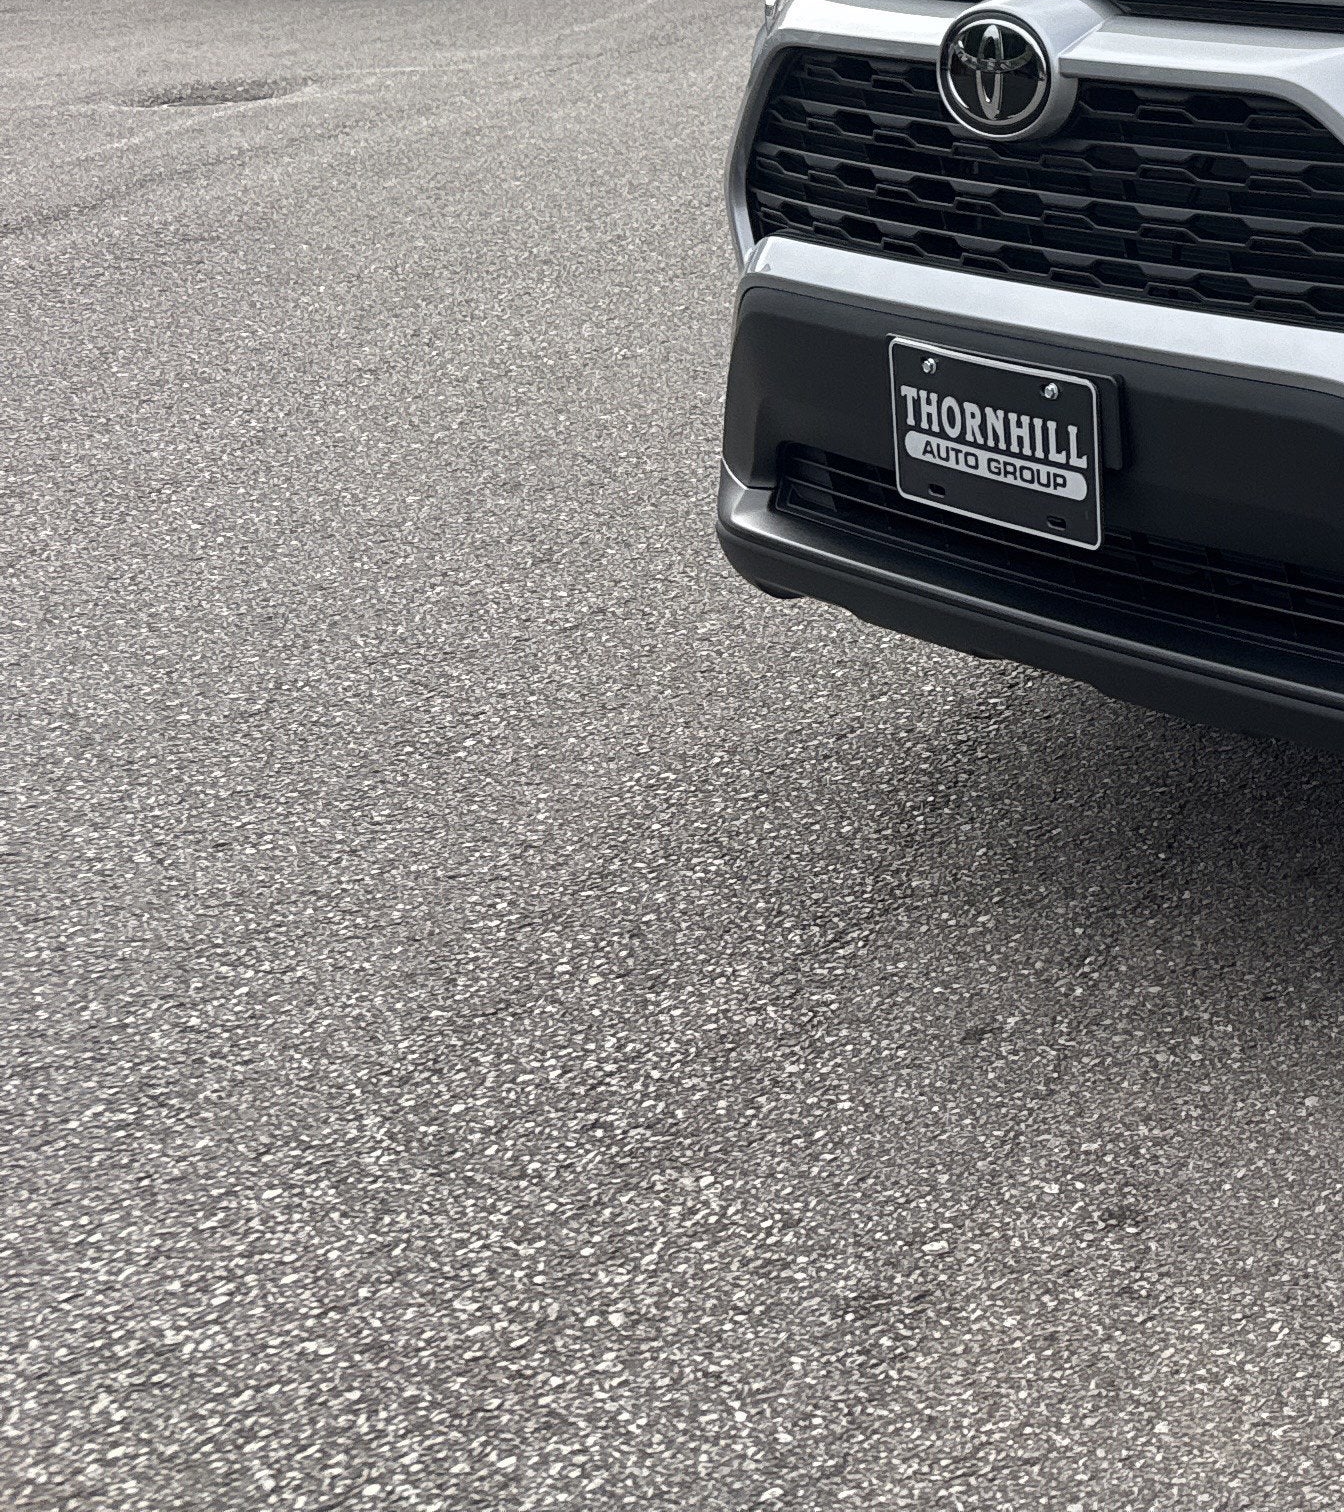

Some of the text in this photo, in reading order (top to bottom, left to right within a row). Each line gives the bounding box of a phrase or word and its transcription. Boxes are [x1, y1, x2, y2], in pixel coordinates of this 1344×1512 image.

[900, 385, 1088, 469] THORNHILL
[922, 440, 1067, 490] AUTO GROUP
